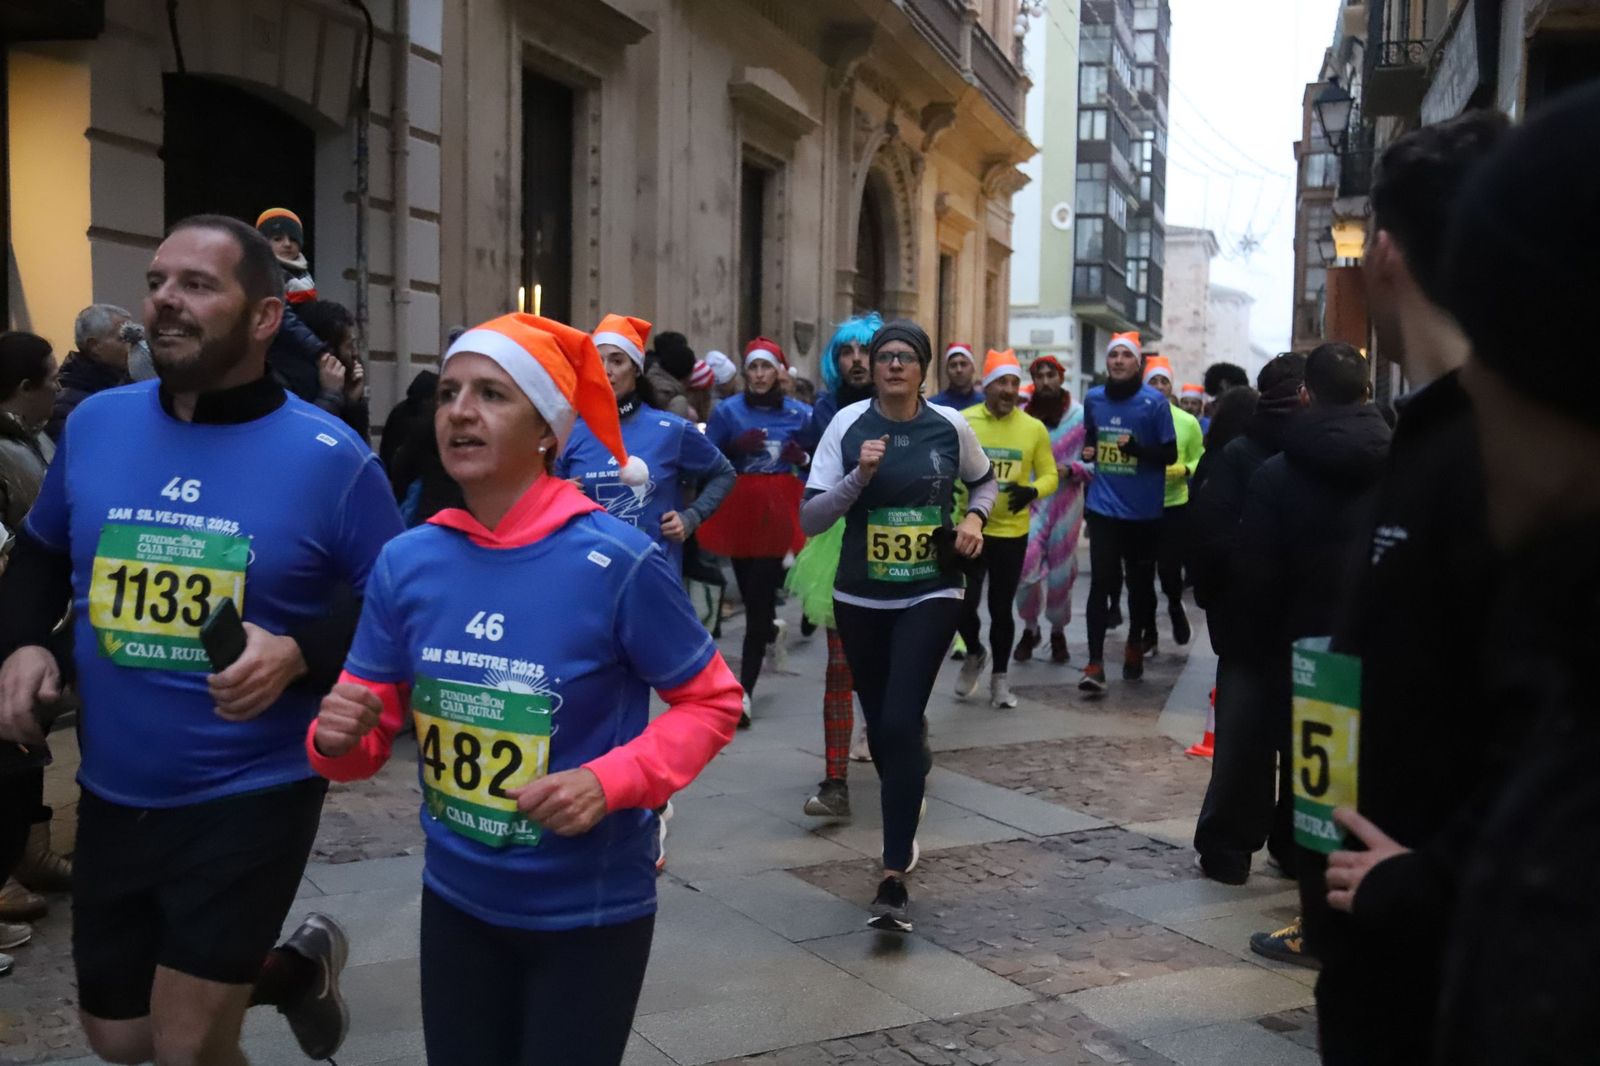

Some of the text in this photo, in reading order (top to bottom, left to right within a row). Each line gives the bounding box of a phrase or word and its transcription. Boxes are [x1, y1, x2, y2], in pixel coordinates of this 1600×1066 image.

[619, 402, 633, 414] HH
[161, 476, 201, 503] 46
[108, 508, 240, 533] SAN SILVESTRE 2025
[136, 543, 205, 559] CAJA RURAL
[889, 567, 910, 576] CAJA
[107, 564, 212, 628] 1133
[465, 611, 505, 642] 46
[125, 641, 211, 662] CAJA RUR
[421, 647, 545, 679] SAN SILVESTRE 2025
[439, 699, 505, 721] CAJA RURAL
[422, 723, 523, 799] 482
[446, 805, 533, 837] CAJA RURAL
